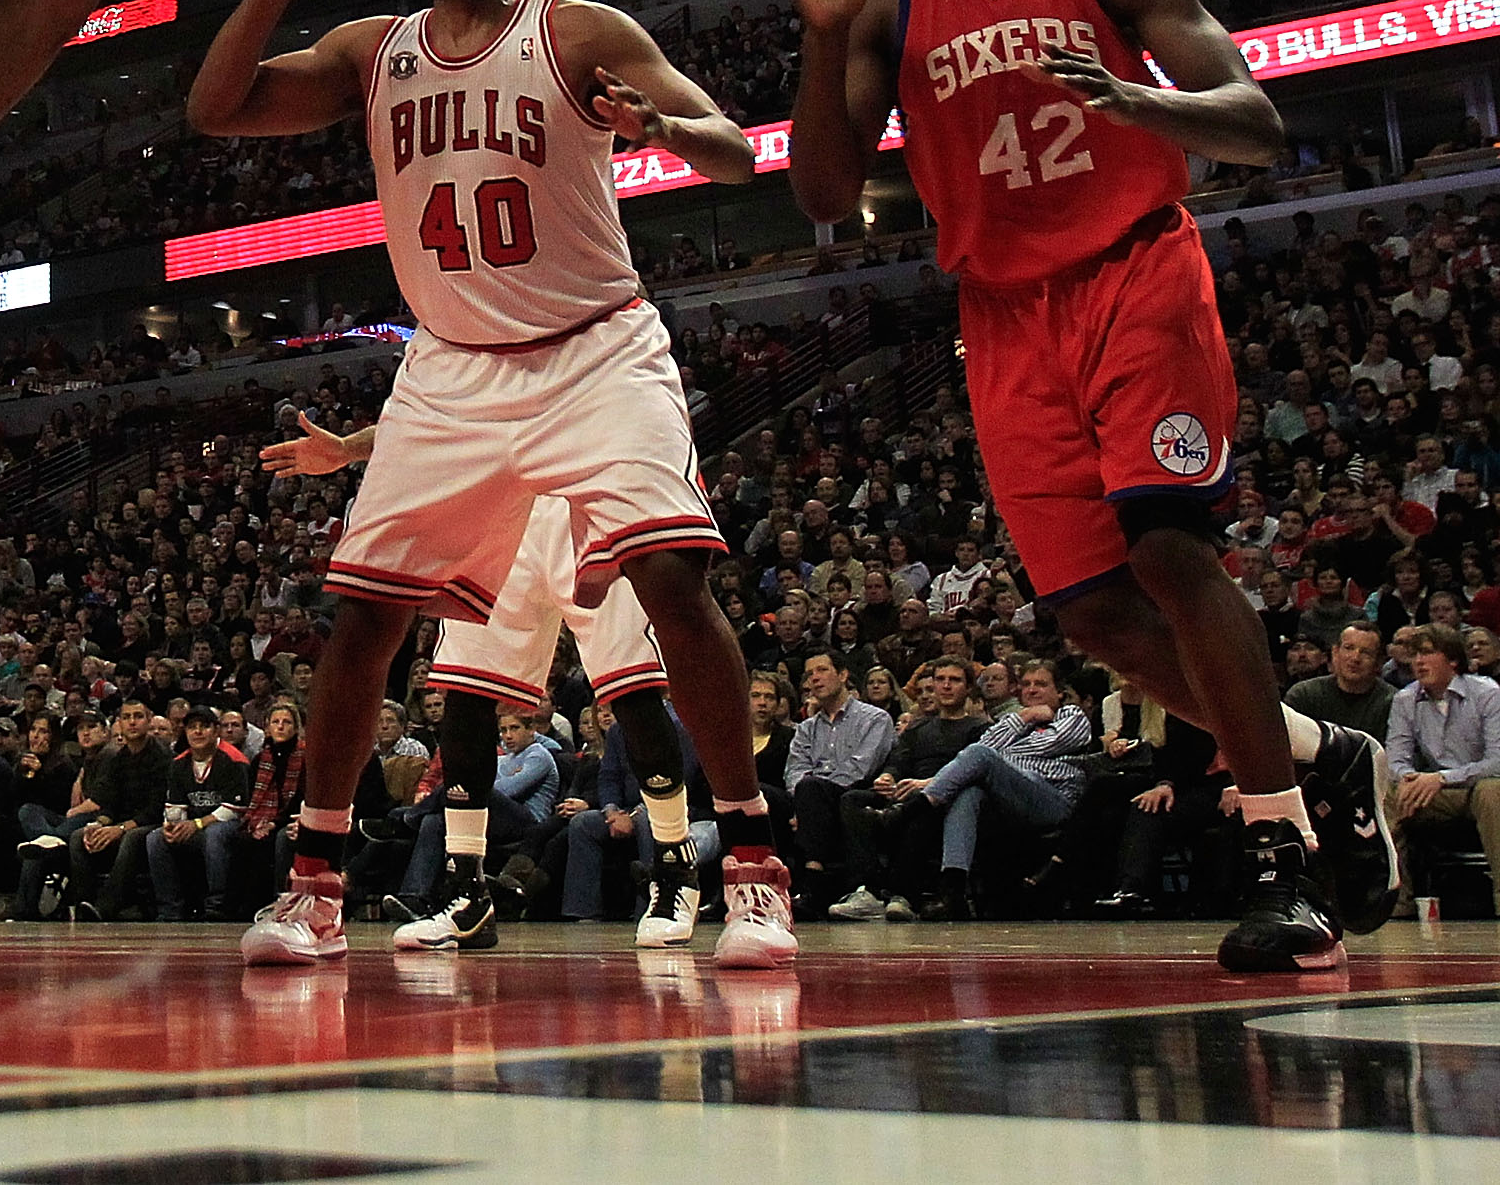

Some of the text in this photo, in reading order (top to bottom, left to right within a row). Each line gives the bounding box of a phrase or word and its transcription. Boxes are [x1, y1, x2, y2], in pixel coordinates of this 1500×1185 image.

[926, 17, 1101, 104] SIXERS
[1277, 11, 1418, 66] BULLS.
[390, 88, 547, 176] BULLS
[979, 100, 1095, 191] 42
[418, 175, 538, 273] 40
